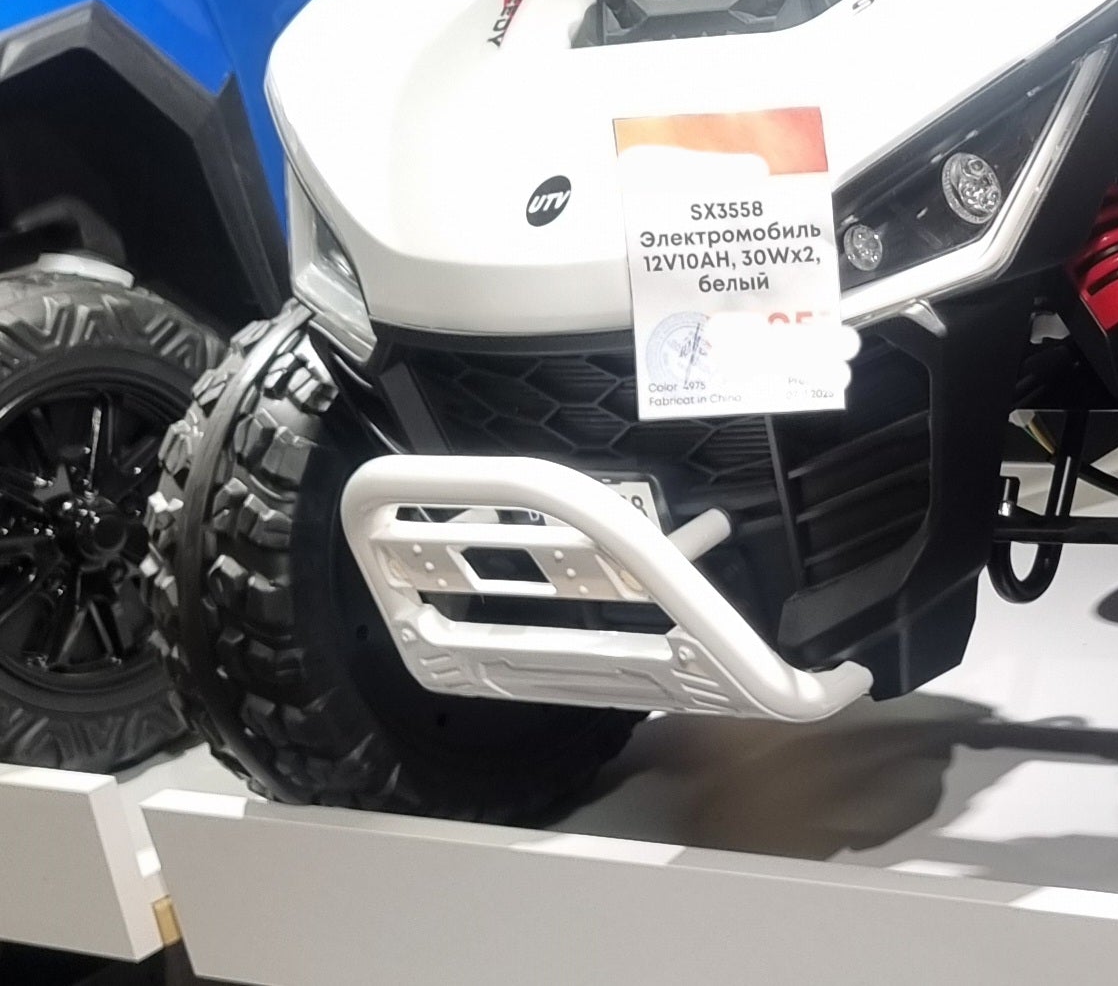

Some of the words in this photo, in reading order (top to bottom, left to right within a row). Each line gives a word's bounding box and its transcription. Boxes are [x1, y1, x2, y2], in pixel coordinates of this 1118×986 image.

[528, 190, 571, 214] UTV
[690, 201, 763, 220] SX3558
[640, 221, 821, 248] Электромобиль
[643, 250, 736, 272] 12V10AH,
[741, 246, 821, 266] 30Wx2,
[698, 272, 769, 293] белый
[649, 396, 694, 407] Fabricat
[697, 396, 707, 404] in
